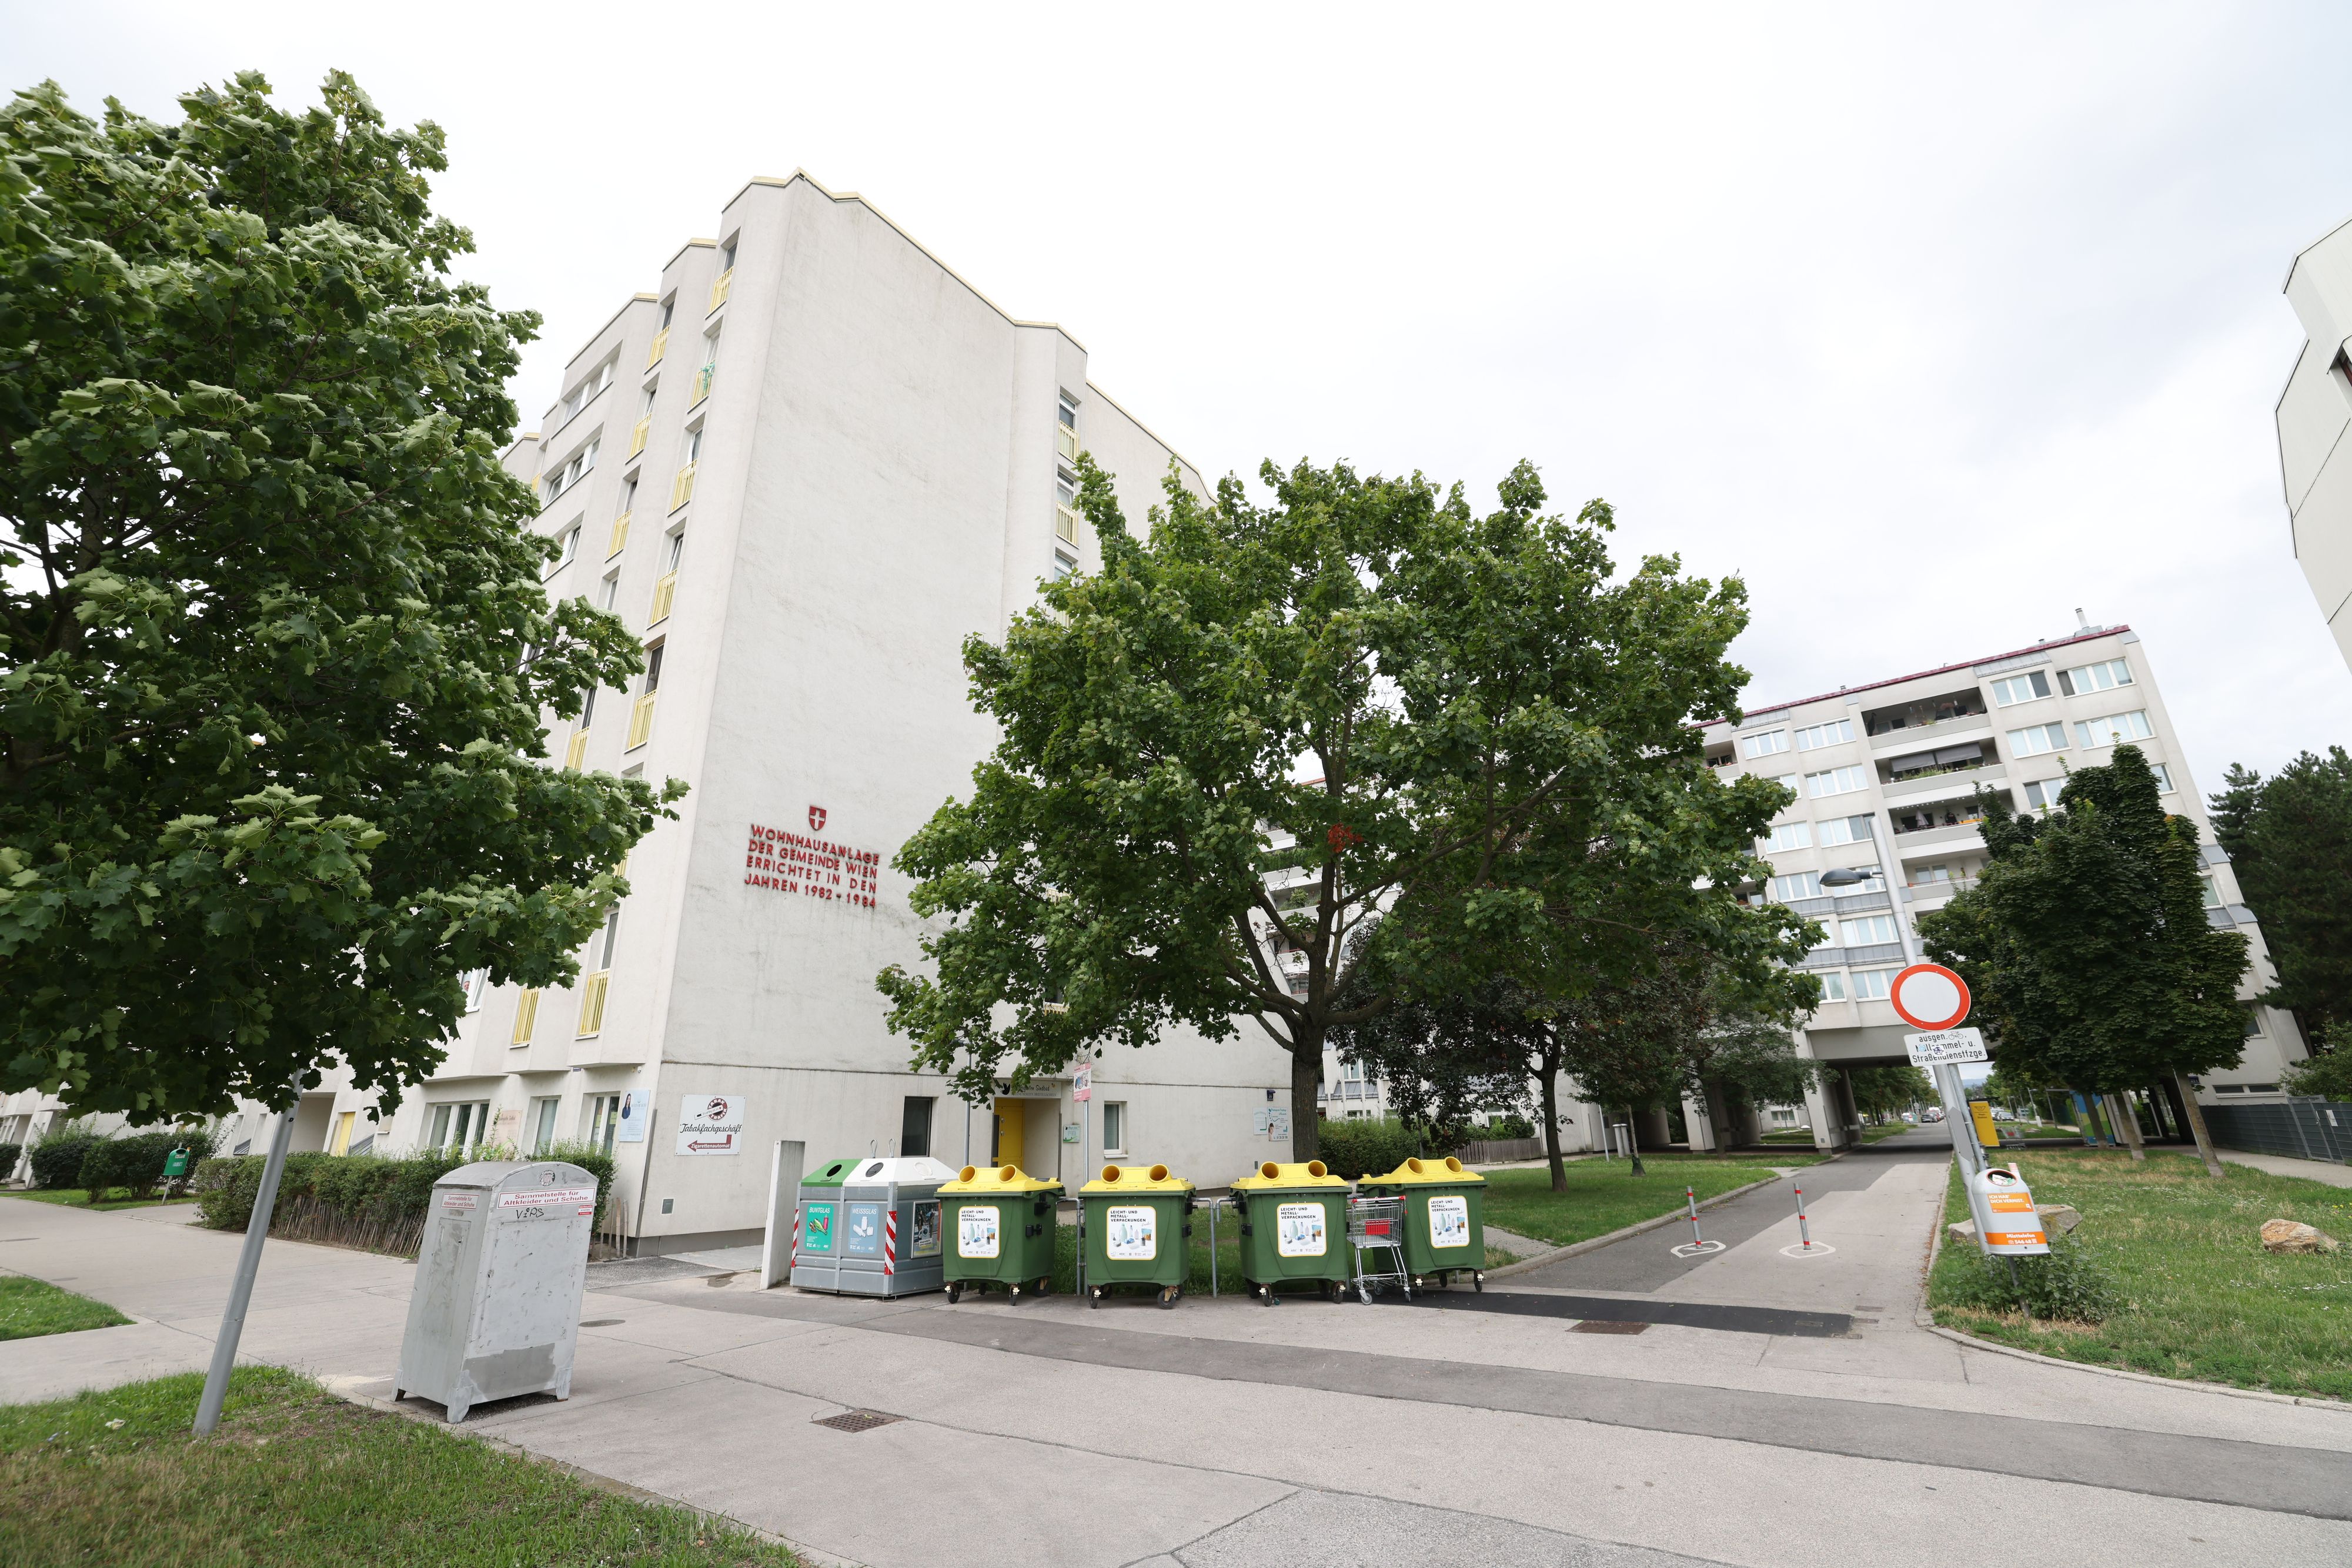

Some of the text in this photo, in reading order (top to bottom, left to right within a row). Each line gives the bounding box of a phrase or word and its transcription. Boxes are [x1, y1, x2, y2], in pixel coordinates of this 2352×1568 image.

[751, 824, 879, 865] WOHNHAUSANLAGE
[748, 839, 877, 878] DER GEMEINDE WIEN
[746, 855, 877, 893] ERRICHTET IN DEN
[744, 873, 797, 892] JAHREN
[805, 884, 833, 900] 1982
[847, 893, 876, 908] 1984
[1919, 1034, 1947, 1042] ausgen.
[1915, 1041, 1965, 1052] llmmel-
[708, 1098, 725, 1109] TABAK
[710, 1108, 727, 1120] TRAFIK
[680, 1123, 742, 1134] Tabakfachgeschäft
